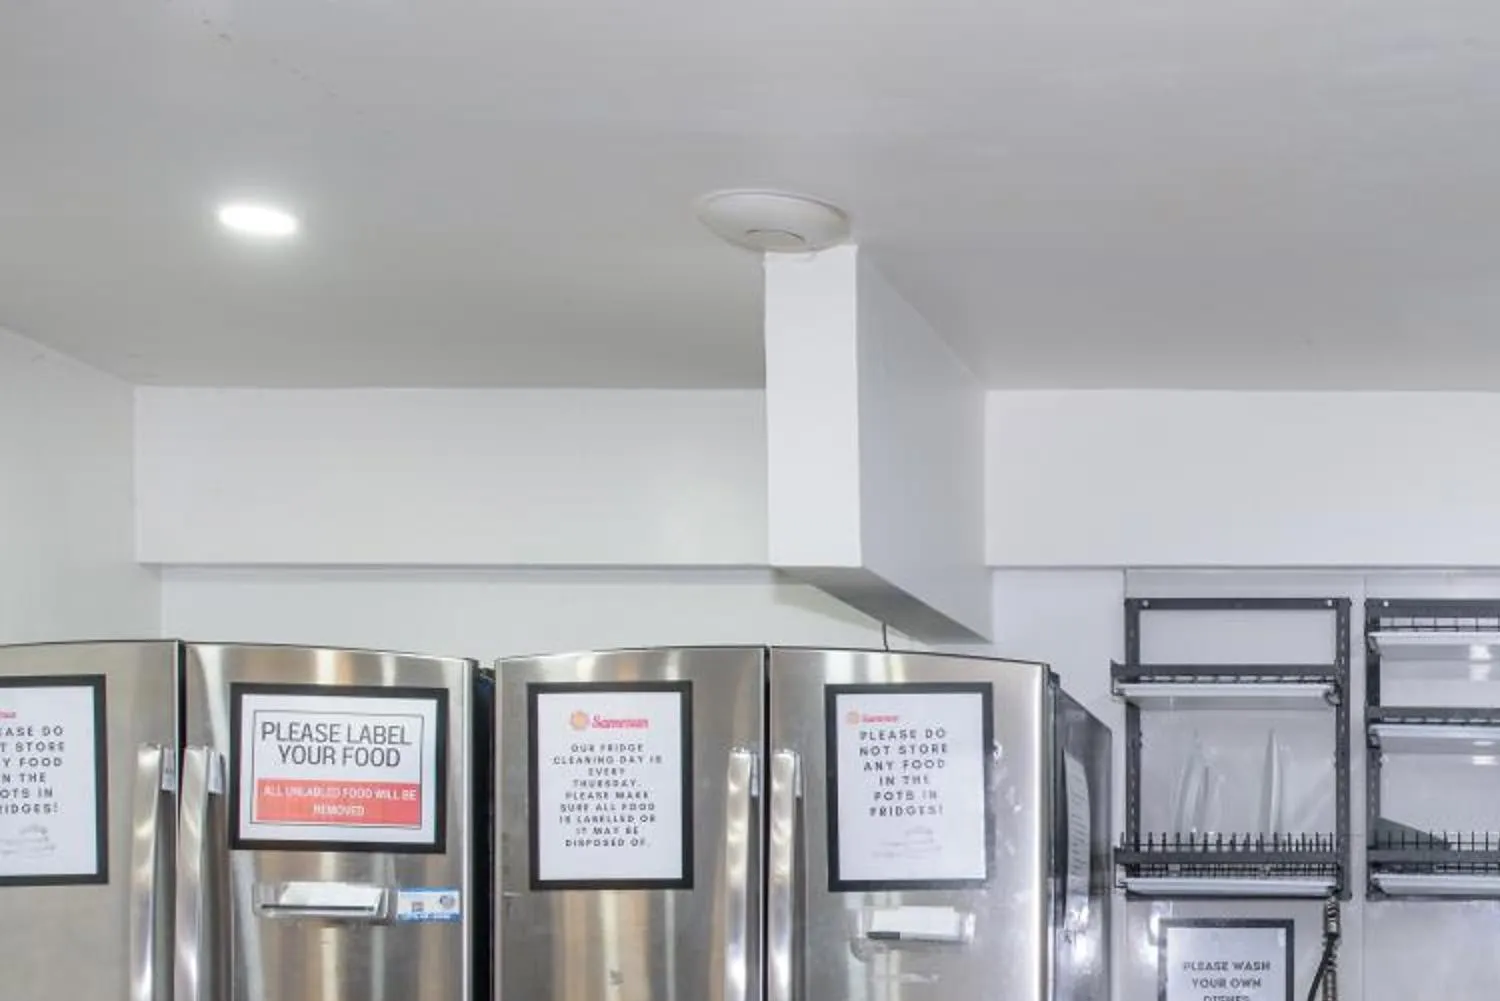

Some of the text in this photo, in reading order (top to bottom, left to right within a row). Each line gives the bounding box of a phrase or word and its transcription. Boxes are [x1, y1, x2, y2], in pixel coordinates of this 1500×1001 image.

[0, 725, 63, 737] ASE DO
[261, 721, 412, 745] PLEASE LABEL
[859, 727, 946, 741] PLEASE DO
[15, 741, 65, 752] STORE
[570, 743, 645, 753] OUR FRIDGE
[859, 743, 948, 757] NOT STORE
[278, 744, 401, 767] YOUR FOOD
[553, 755, 615, 765] CLEANING
[619, 755, 643, 765] DAY
[19, 757, 62, 768] FOOD
[863, 759, 945, 772] ANY FOOD
[19, 772, 46, 784] THE
[879, 775, 929, 786] IN THE
[0, 786, 53, 798] OTS IN
[343, 787, 373, 800] FOOD
[873, 789, 938, 801] POTS IN
[0, 802, 59, 814] IDGES!
[595, 803, 617, 812] ALL
[621, 802, 655, 811] FOOD
[1183, 960, 1271, 971] PLEASE WASH
[1191, 977, 1263, 989] YOUR OWN
